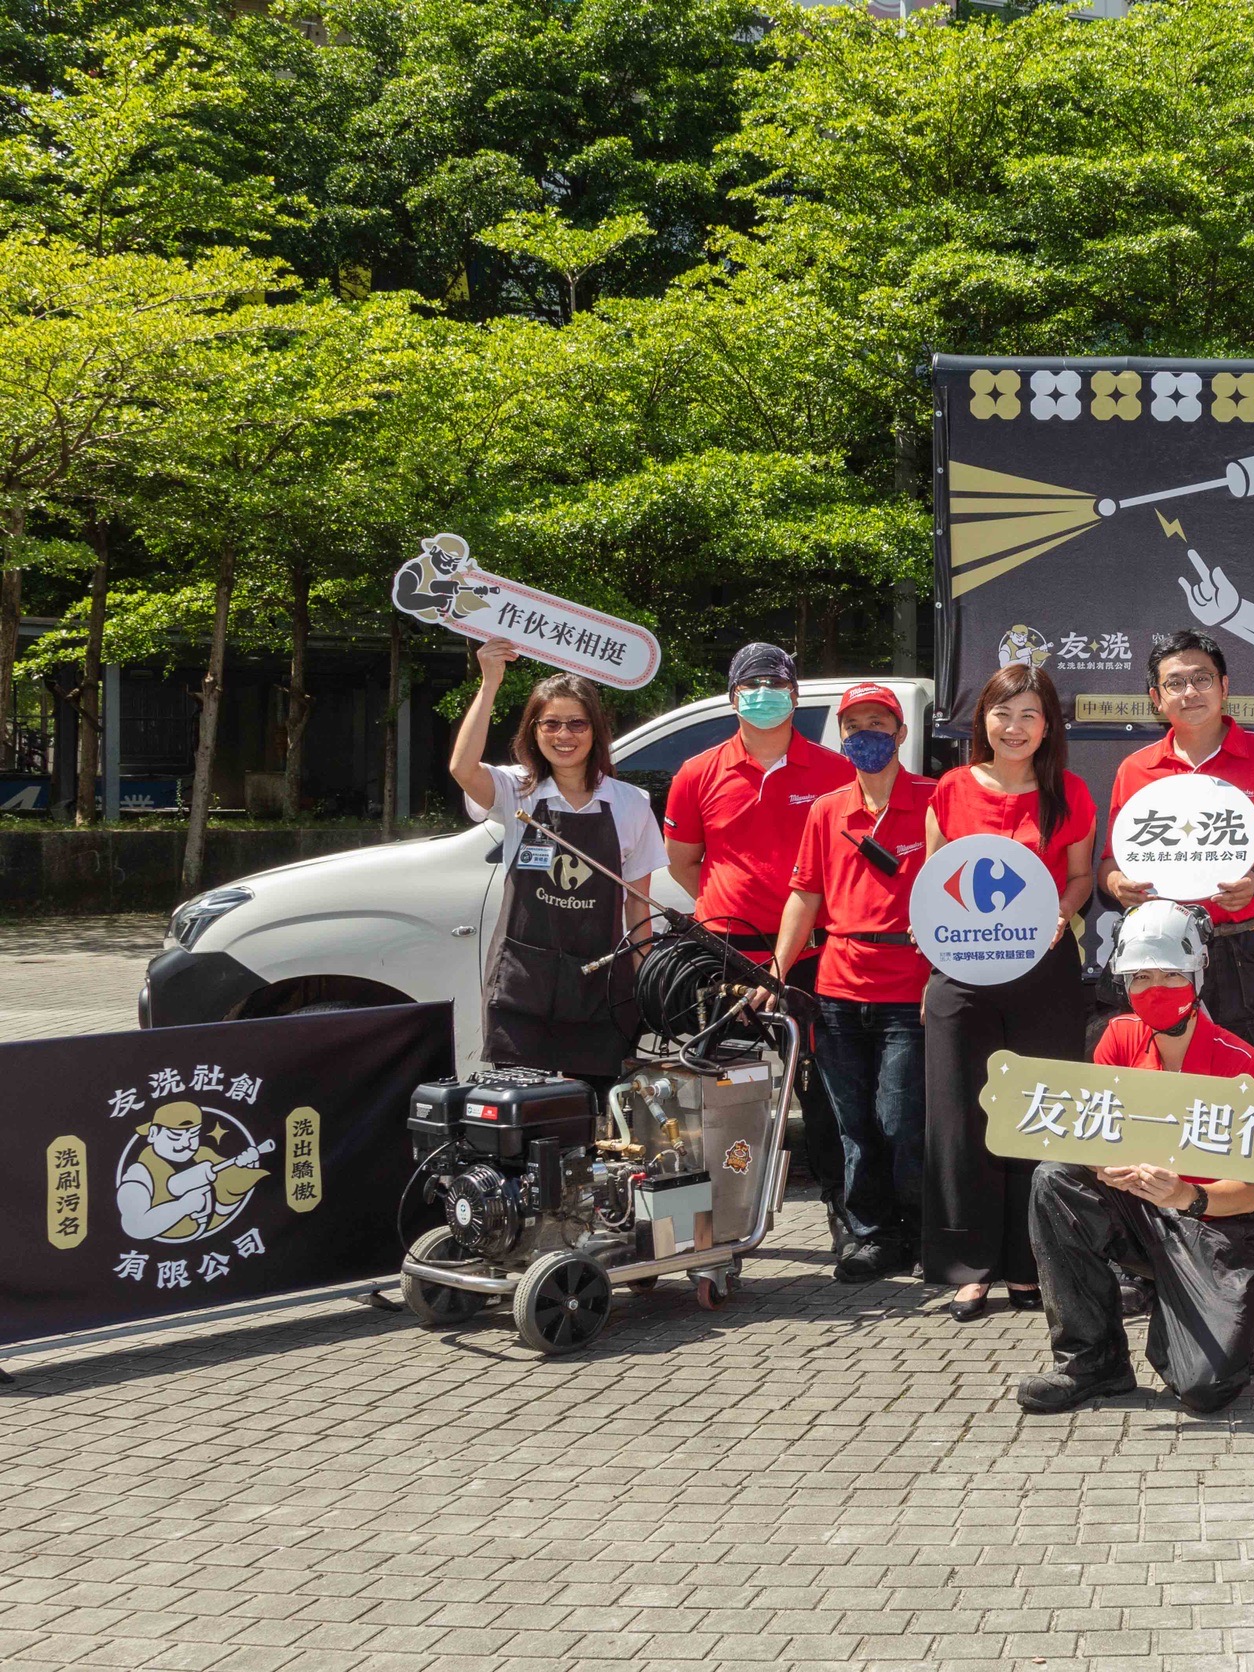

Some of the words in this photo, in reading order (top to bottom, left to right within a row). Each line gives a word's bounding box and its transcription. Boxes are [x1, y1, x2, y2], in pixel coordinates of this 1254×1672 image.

[497, 601, 628, 667] 作伙來相挺
[1056, 631, 1133, 660] 友洗
[1056, 661, 1132, 671] 友洗社創有限公司
[1126, 808, 1250, 848] 友洗
[1126, 850, 1248, 863] 友洗社創有限公司
[934, 922, 1038, 943] Carrefour
[953, 949, 1036, 962] 家樂福文教基金會
[107, 1064, 263, 1119] 友洗社創
[290, 1118, 318, 1201] 洗出驕傲
[54, 1148, 82, 1237] 洗刷污名
[113, 1226, 266, 1289] 有限公司
